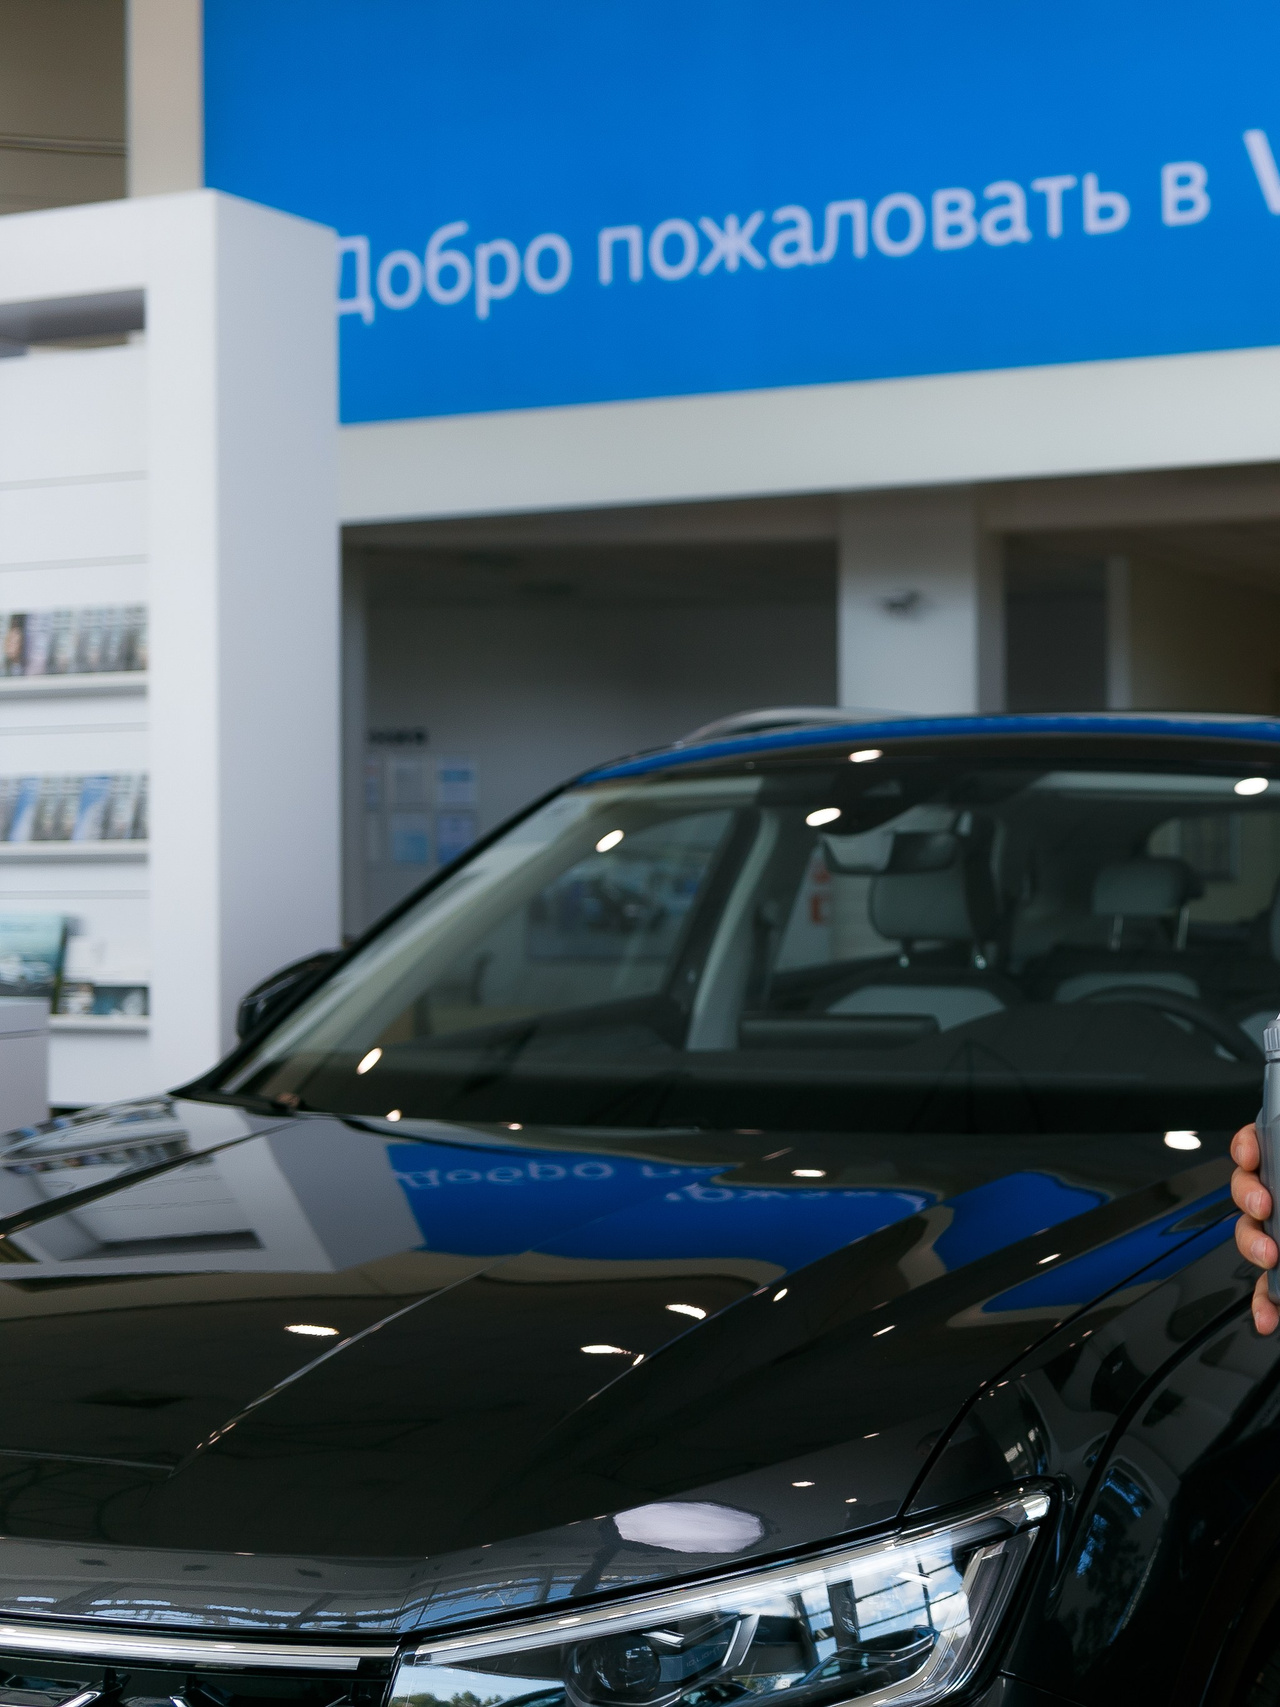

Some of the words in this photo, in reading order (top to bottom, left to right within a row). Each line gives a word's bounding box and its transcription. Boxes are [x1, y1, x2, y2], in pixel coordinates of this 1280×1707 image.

[337, 219, 573, 327] Добро
[599, 173, 1131, 286] пожаловать
[1160, 160, 1212, 228] в
